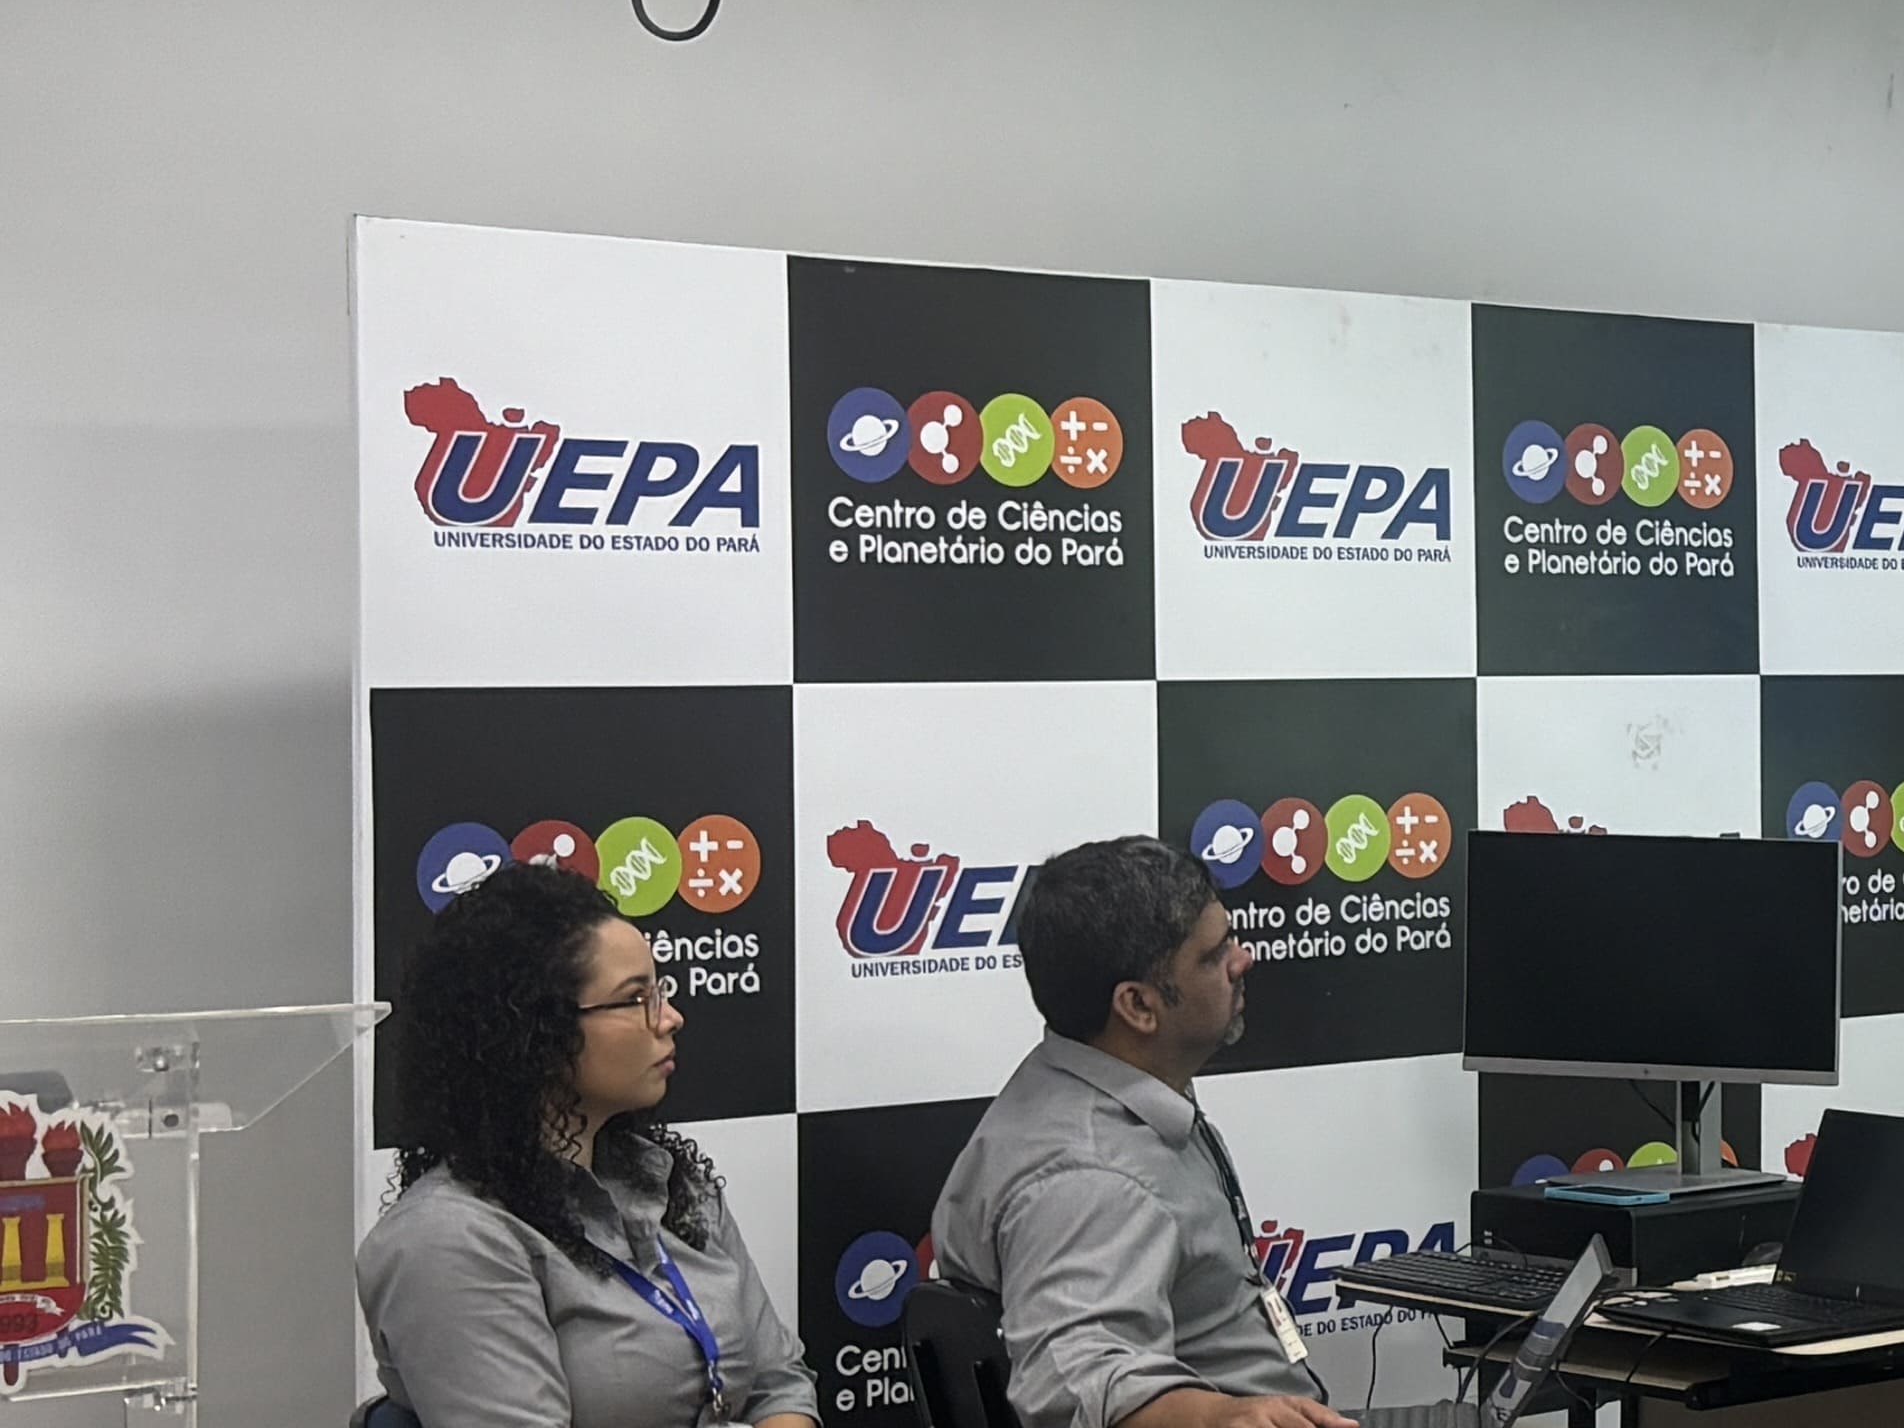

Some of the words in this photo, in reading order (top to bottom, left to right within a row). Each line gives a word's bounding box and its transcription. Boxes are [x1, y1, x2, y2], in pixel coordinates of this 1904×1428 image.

[431, 432, 761, 526] UEPA
[828, 496, 936, 530] Centro
[946, 499, 987, 531] de
[997, 500, 1123, 533] Ciências
[1199, 458, 1452, 541] UEPA
[433, 530, 574, 550] UNIVERSIDADE
[578, 533, 605, 551] DO
[610, 534, 680, 552] ESTADO
[685, 536, 711, 552] DO
[716, 533, 760, 553] PARÁ
[1503, 515, 1588, 545] Centro
[1595, 518, 1627, 546] de
[1635, 518, 1734, 548] Ciências
[828, 539, 849, 563] e
[859, 533, 1005, 565] Planetário
[1014, 537, 1052, 566] do
[1061, 537, 1124, 567] Pará
[1203, 544, 1308, 561] UNIVERSIDADE
[1312, 546, 1333, 561] DO
[1336, 546, 1390, 562] ESTADO
[1393, 547, 1413, 562] DO
[1416, 545, 1452, 563] PARÁ
[1504, 553, 1520, 574] e
[1528, 548, 1642, 576] Planetário
[1648, 551, 1679, 576] do
[1685, 551, 1735, 577] Pará
[1295, 897, 1331, 927] de
[1339, 891, 1451, 924] Ciências
[1354, 927, 1388, 955] do
[1396, 921, 1452, 952] Pará
